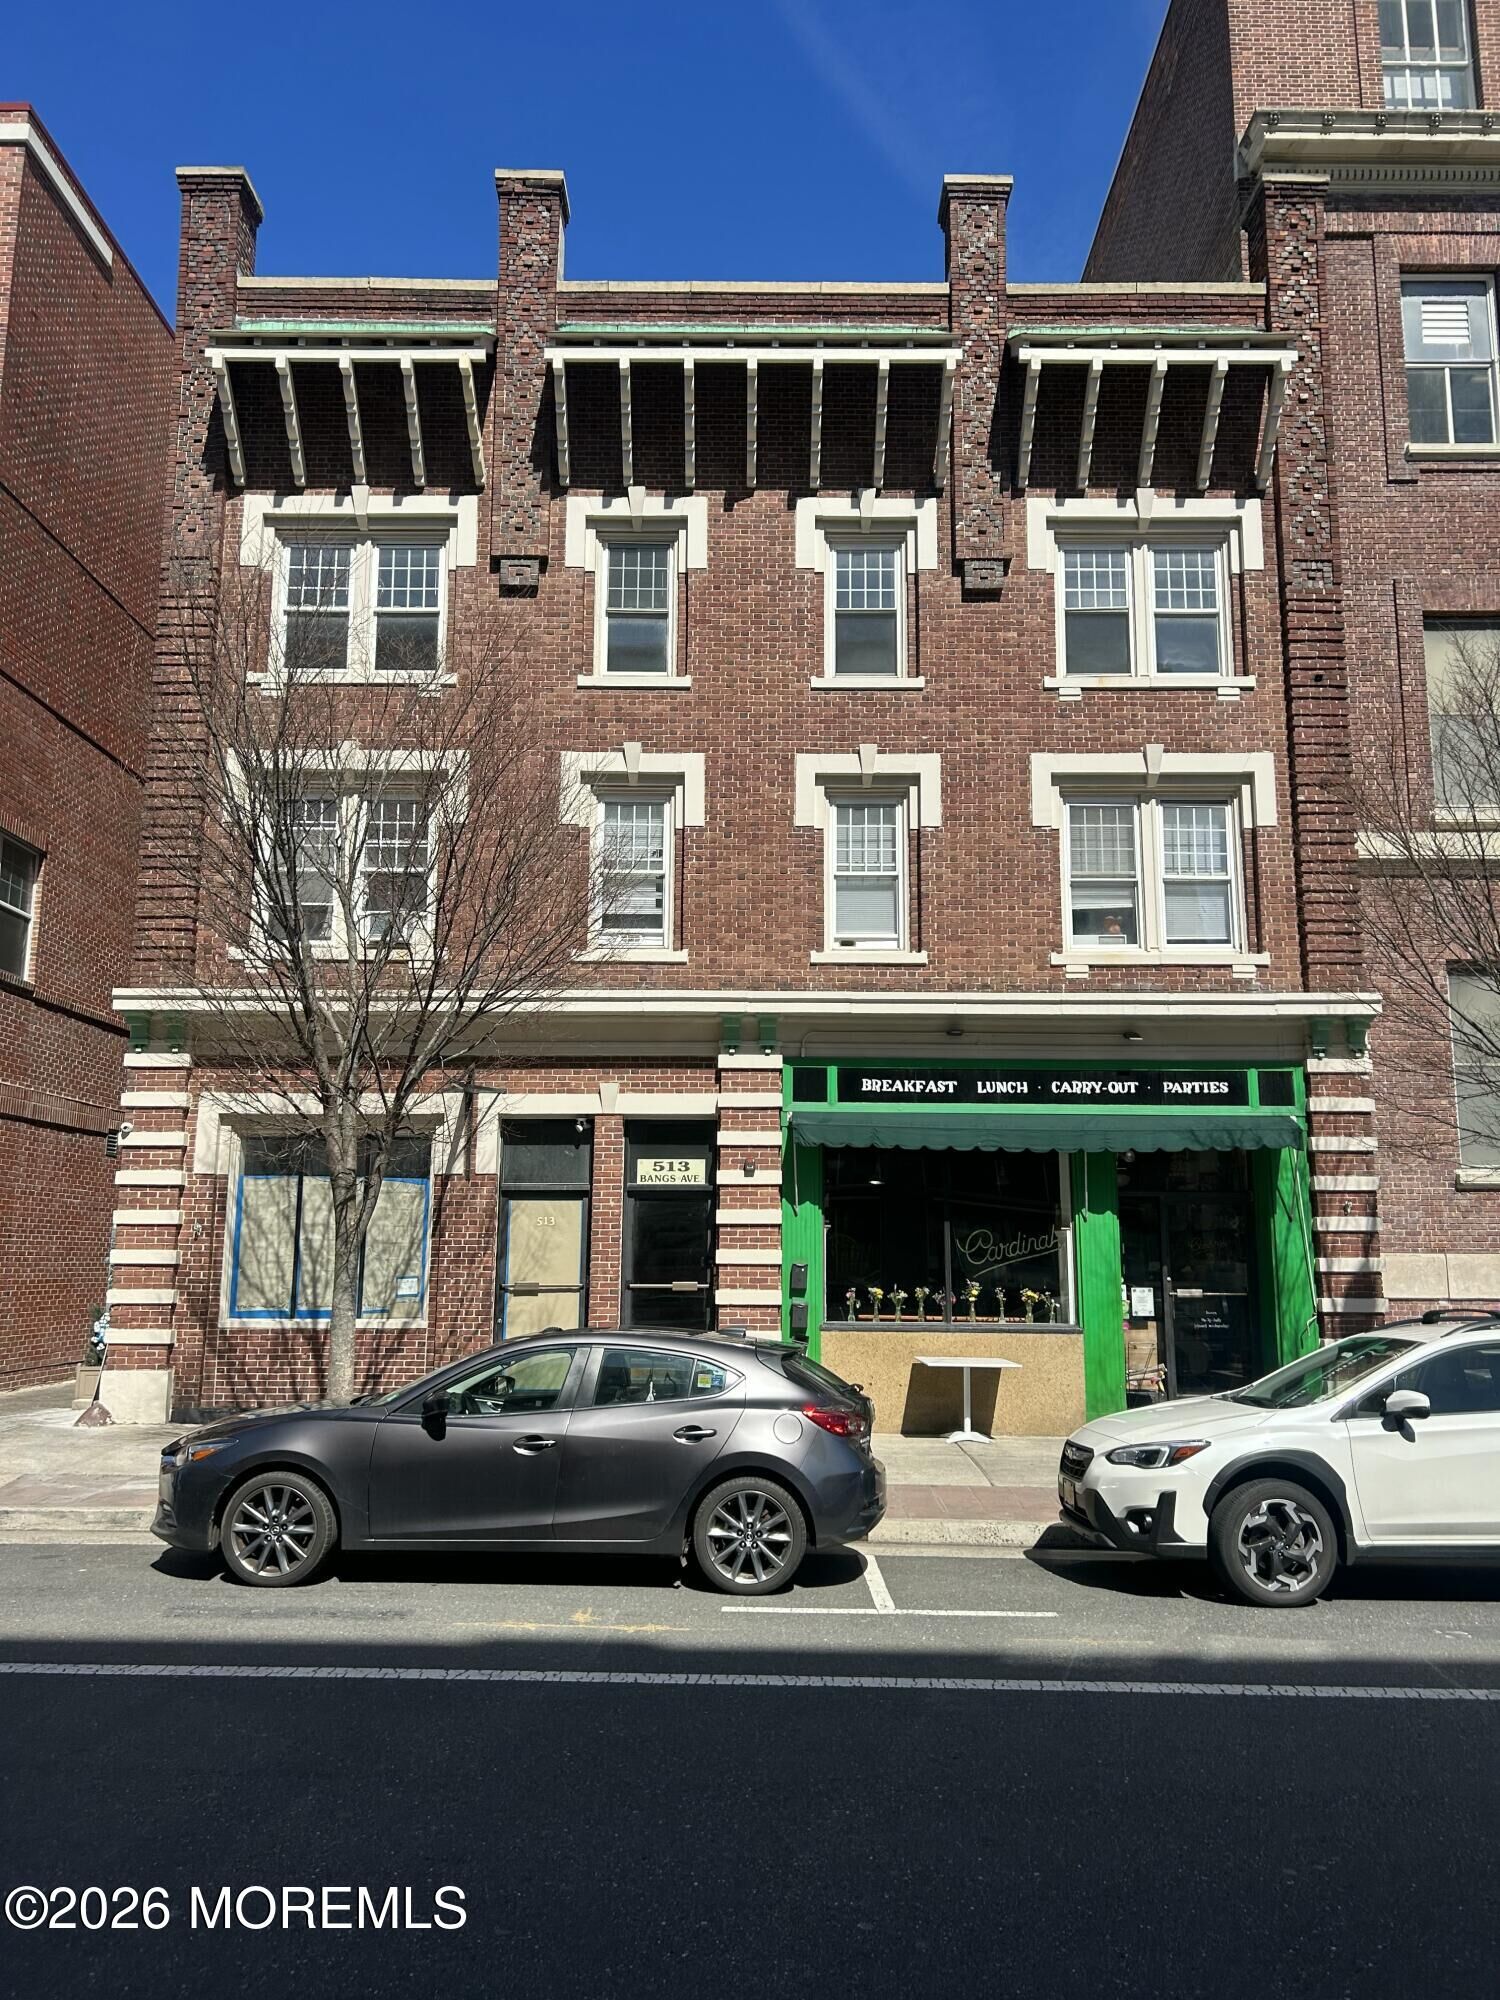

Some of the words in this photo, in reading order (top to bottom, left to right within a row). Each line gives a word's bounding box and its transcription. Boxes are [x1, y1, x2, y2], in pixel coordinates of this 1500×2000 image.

[861, 1078, 957, 1093] BREAKFAST
[977, 1081, 1029, 1094] LUNCH
[1051, 1081, 1139, 1094] CARRY-OUT
[1163, 1081, 1229, 1094] PARTIES
[652, 1161, 691, 1172] 513
[640, 1174, 676, 1183] BANGS
[680, 1174, 700, 1183] AVE
[536, 1216, 555, 1226] 513
[956, 1224, 1060, 1265] Cardinal
